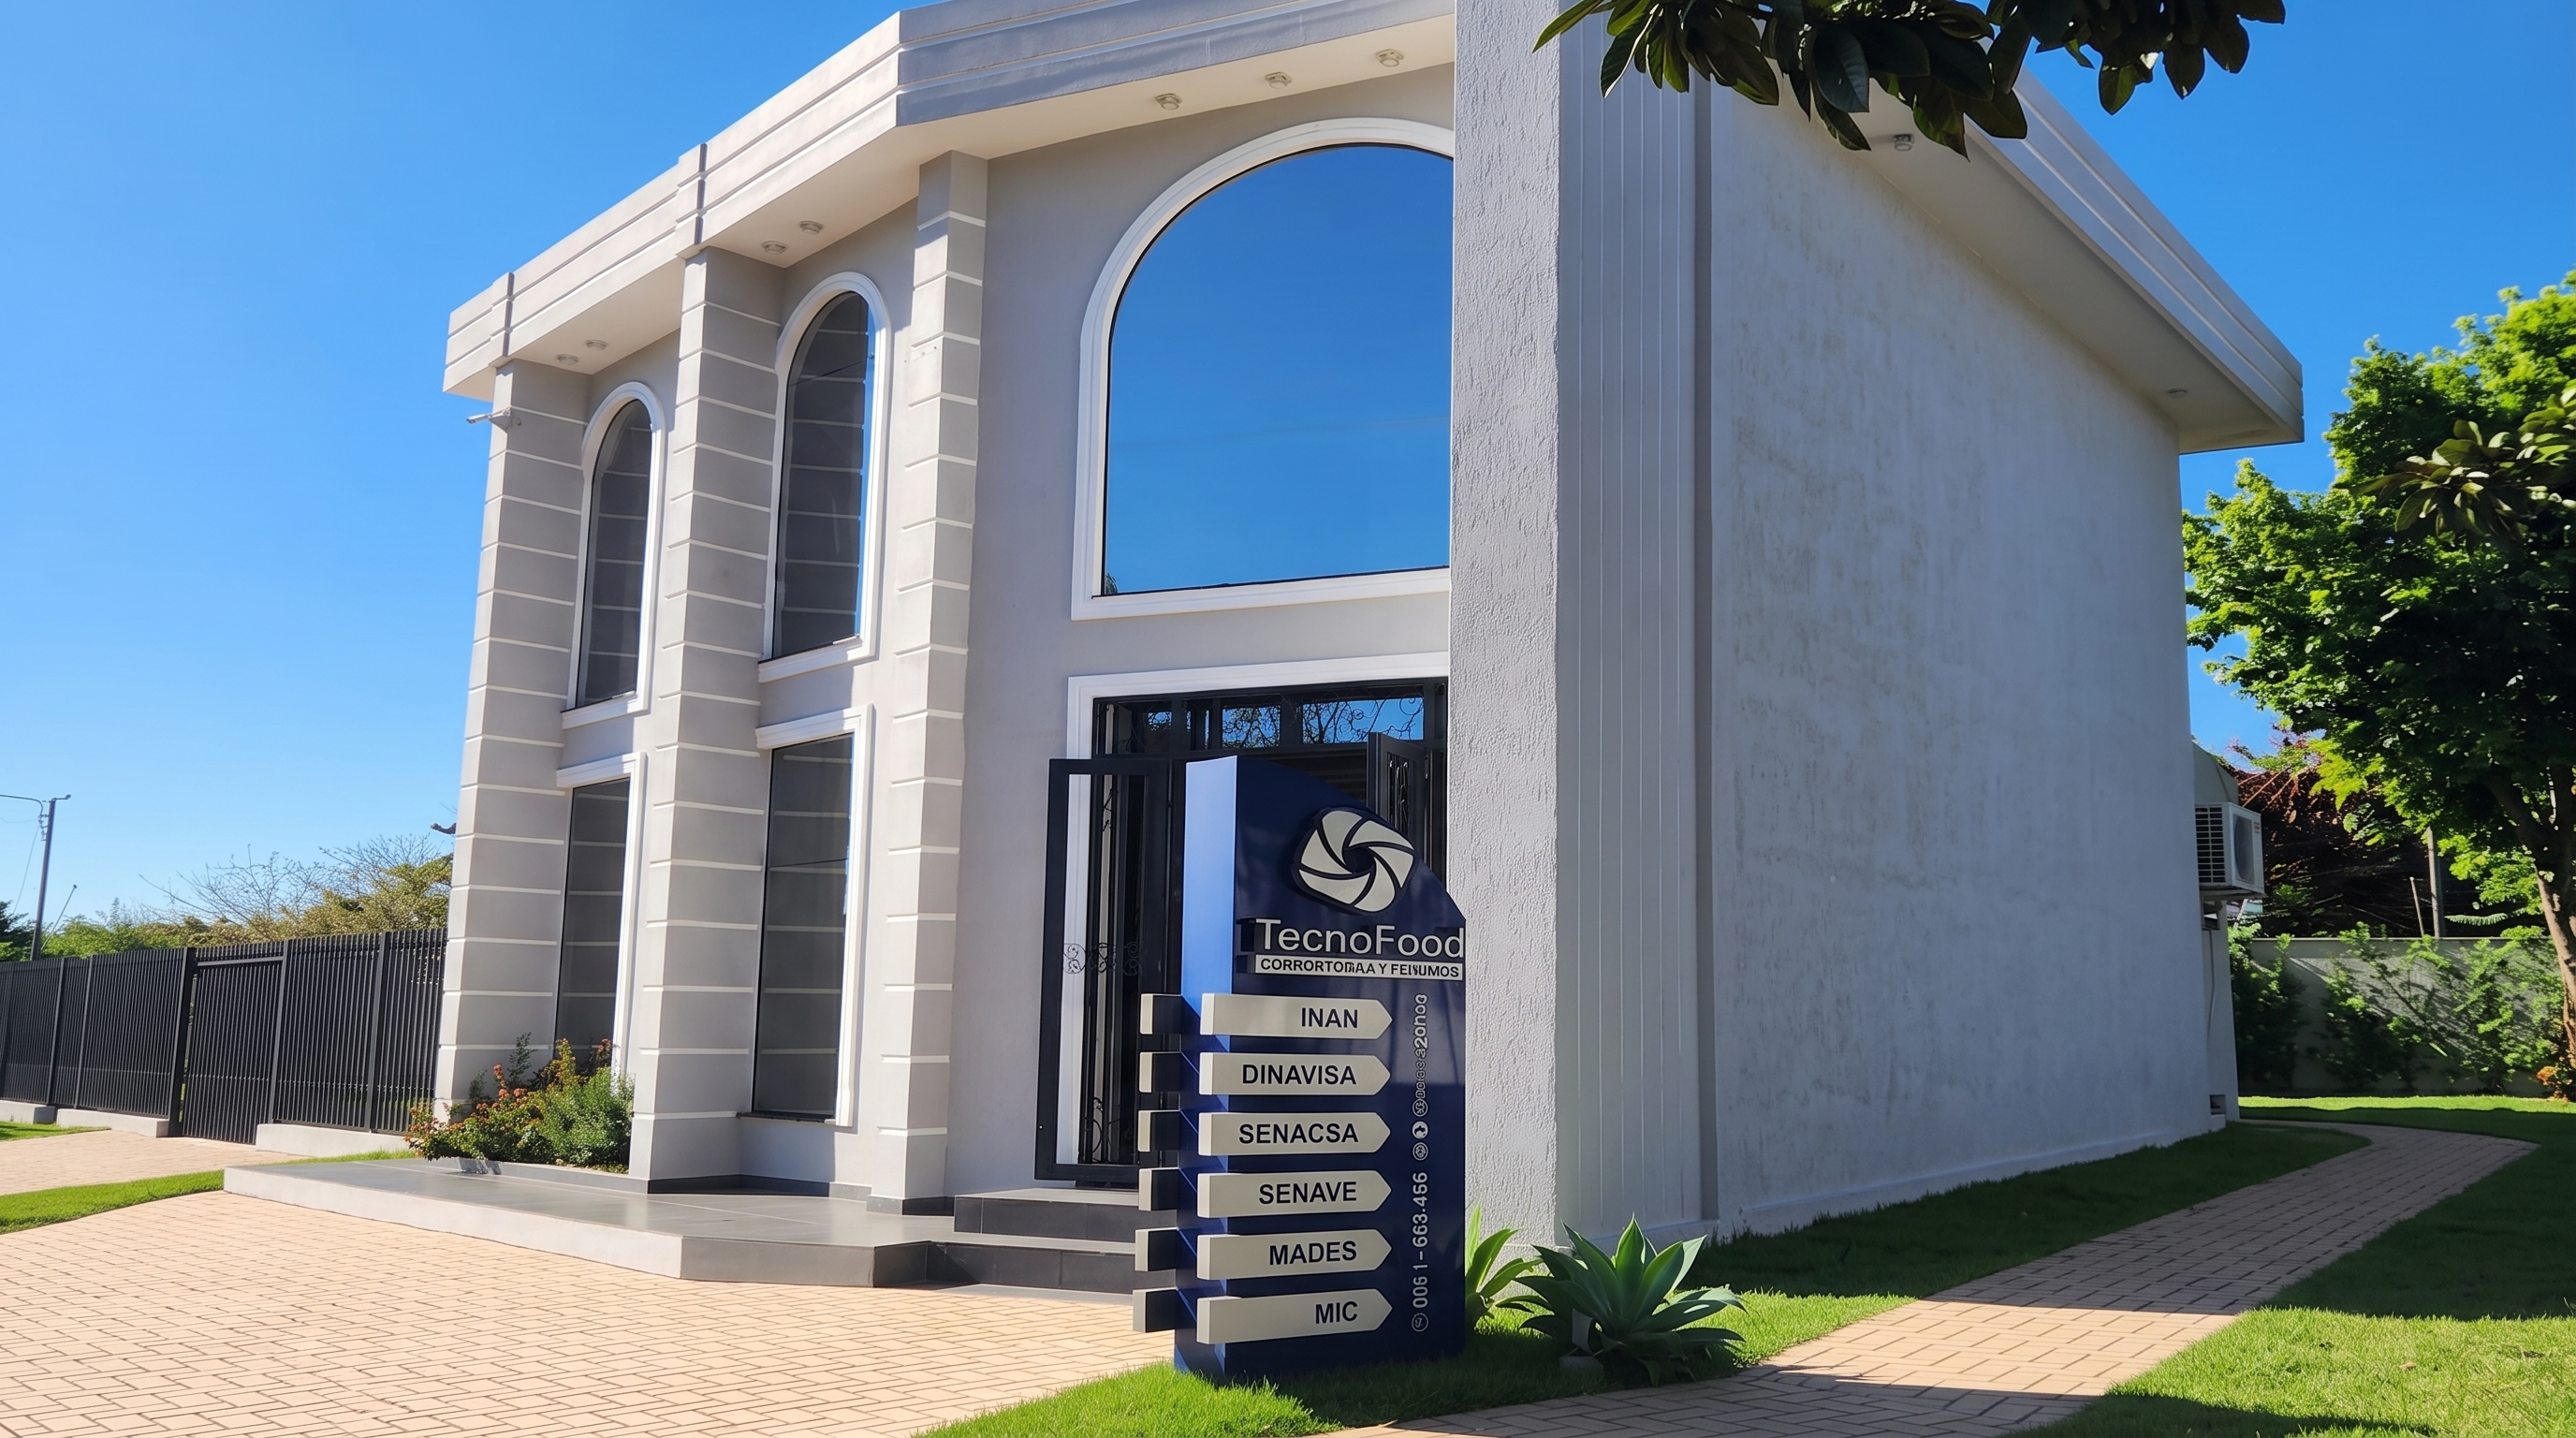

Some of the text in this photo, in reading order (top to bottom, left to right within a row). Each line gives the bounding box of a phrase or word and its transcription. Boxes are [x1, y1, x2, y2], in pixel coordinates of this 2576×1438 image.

[1255, 918, 1464, 958] TecnoFood
[1378, 963, 1387, 975] Y
[1301, 1007, 1358, 1029] INAN
[1242, 1064, 1357, 1085] DINAVISA
[1238, 1123, 1359, 1144] SENACSA
[1258, 1181, 1357, 1205] SENAVE
[1269, 1240, 1357, 1266] MADES
[1315, 1300, 1358, 1325] MIC
